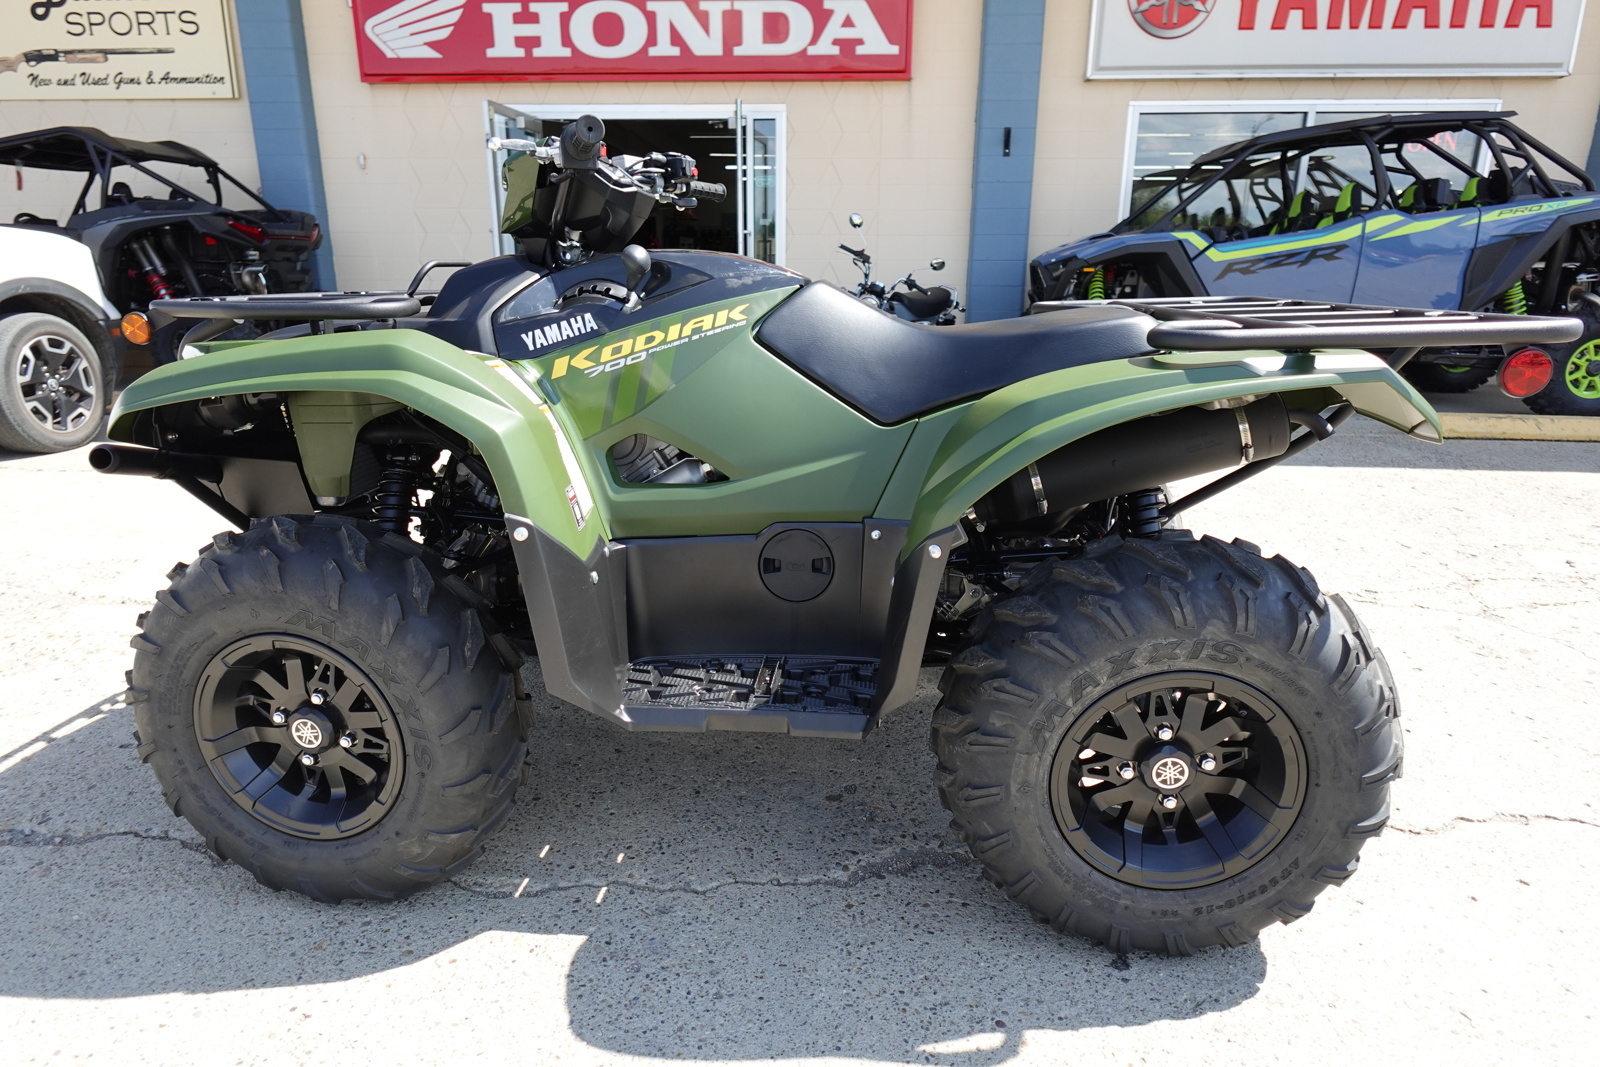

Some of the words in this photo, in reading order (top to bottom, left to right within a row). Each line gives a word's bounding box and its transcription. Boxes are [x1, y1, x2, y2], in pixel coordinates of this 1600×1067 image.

[64, 10, 200, 37] SPORTS
[484, 0, 899, 59] HONDA
[27, 72, 53, 88] New
[56, 74, 77, 87] and
[79, 71, 110, 87] Used
[114, 71, 141, 90] Guns
[146, 70, 156, 85] &
[158, 71, 226, 86] Ammunition
[1213, 243, 1350, 282] RZR
[521, 312, 599, 351] YAMAHA
[551, 303, 750, 379] KODIAK
[648, 338, 689, 355] POWER
[691, 320, 747, 341] STEERING
[584, 350, 647, 379] 700
[285, 609, 434, 771] MAXXIS
[1030, 640, 1246, 753] MAXXIS
